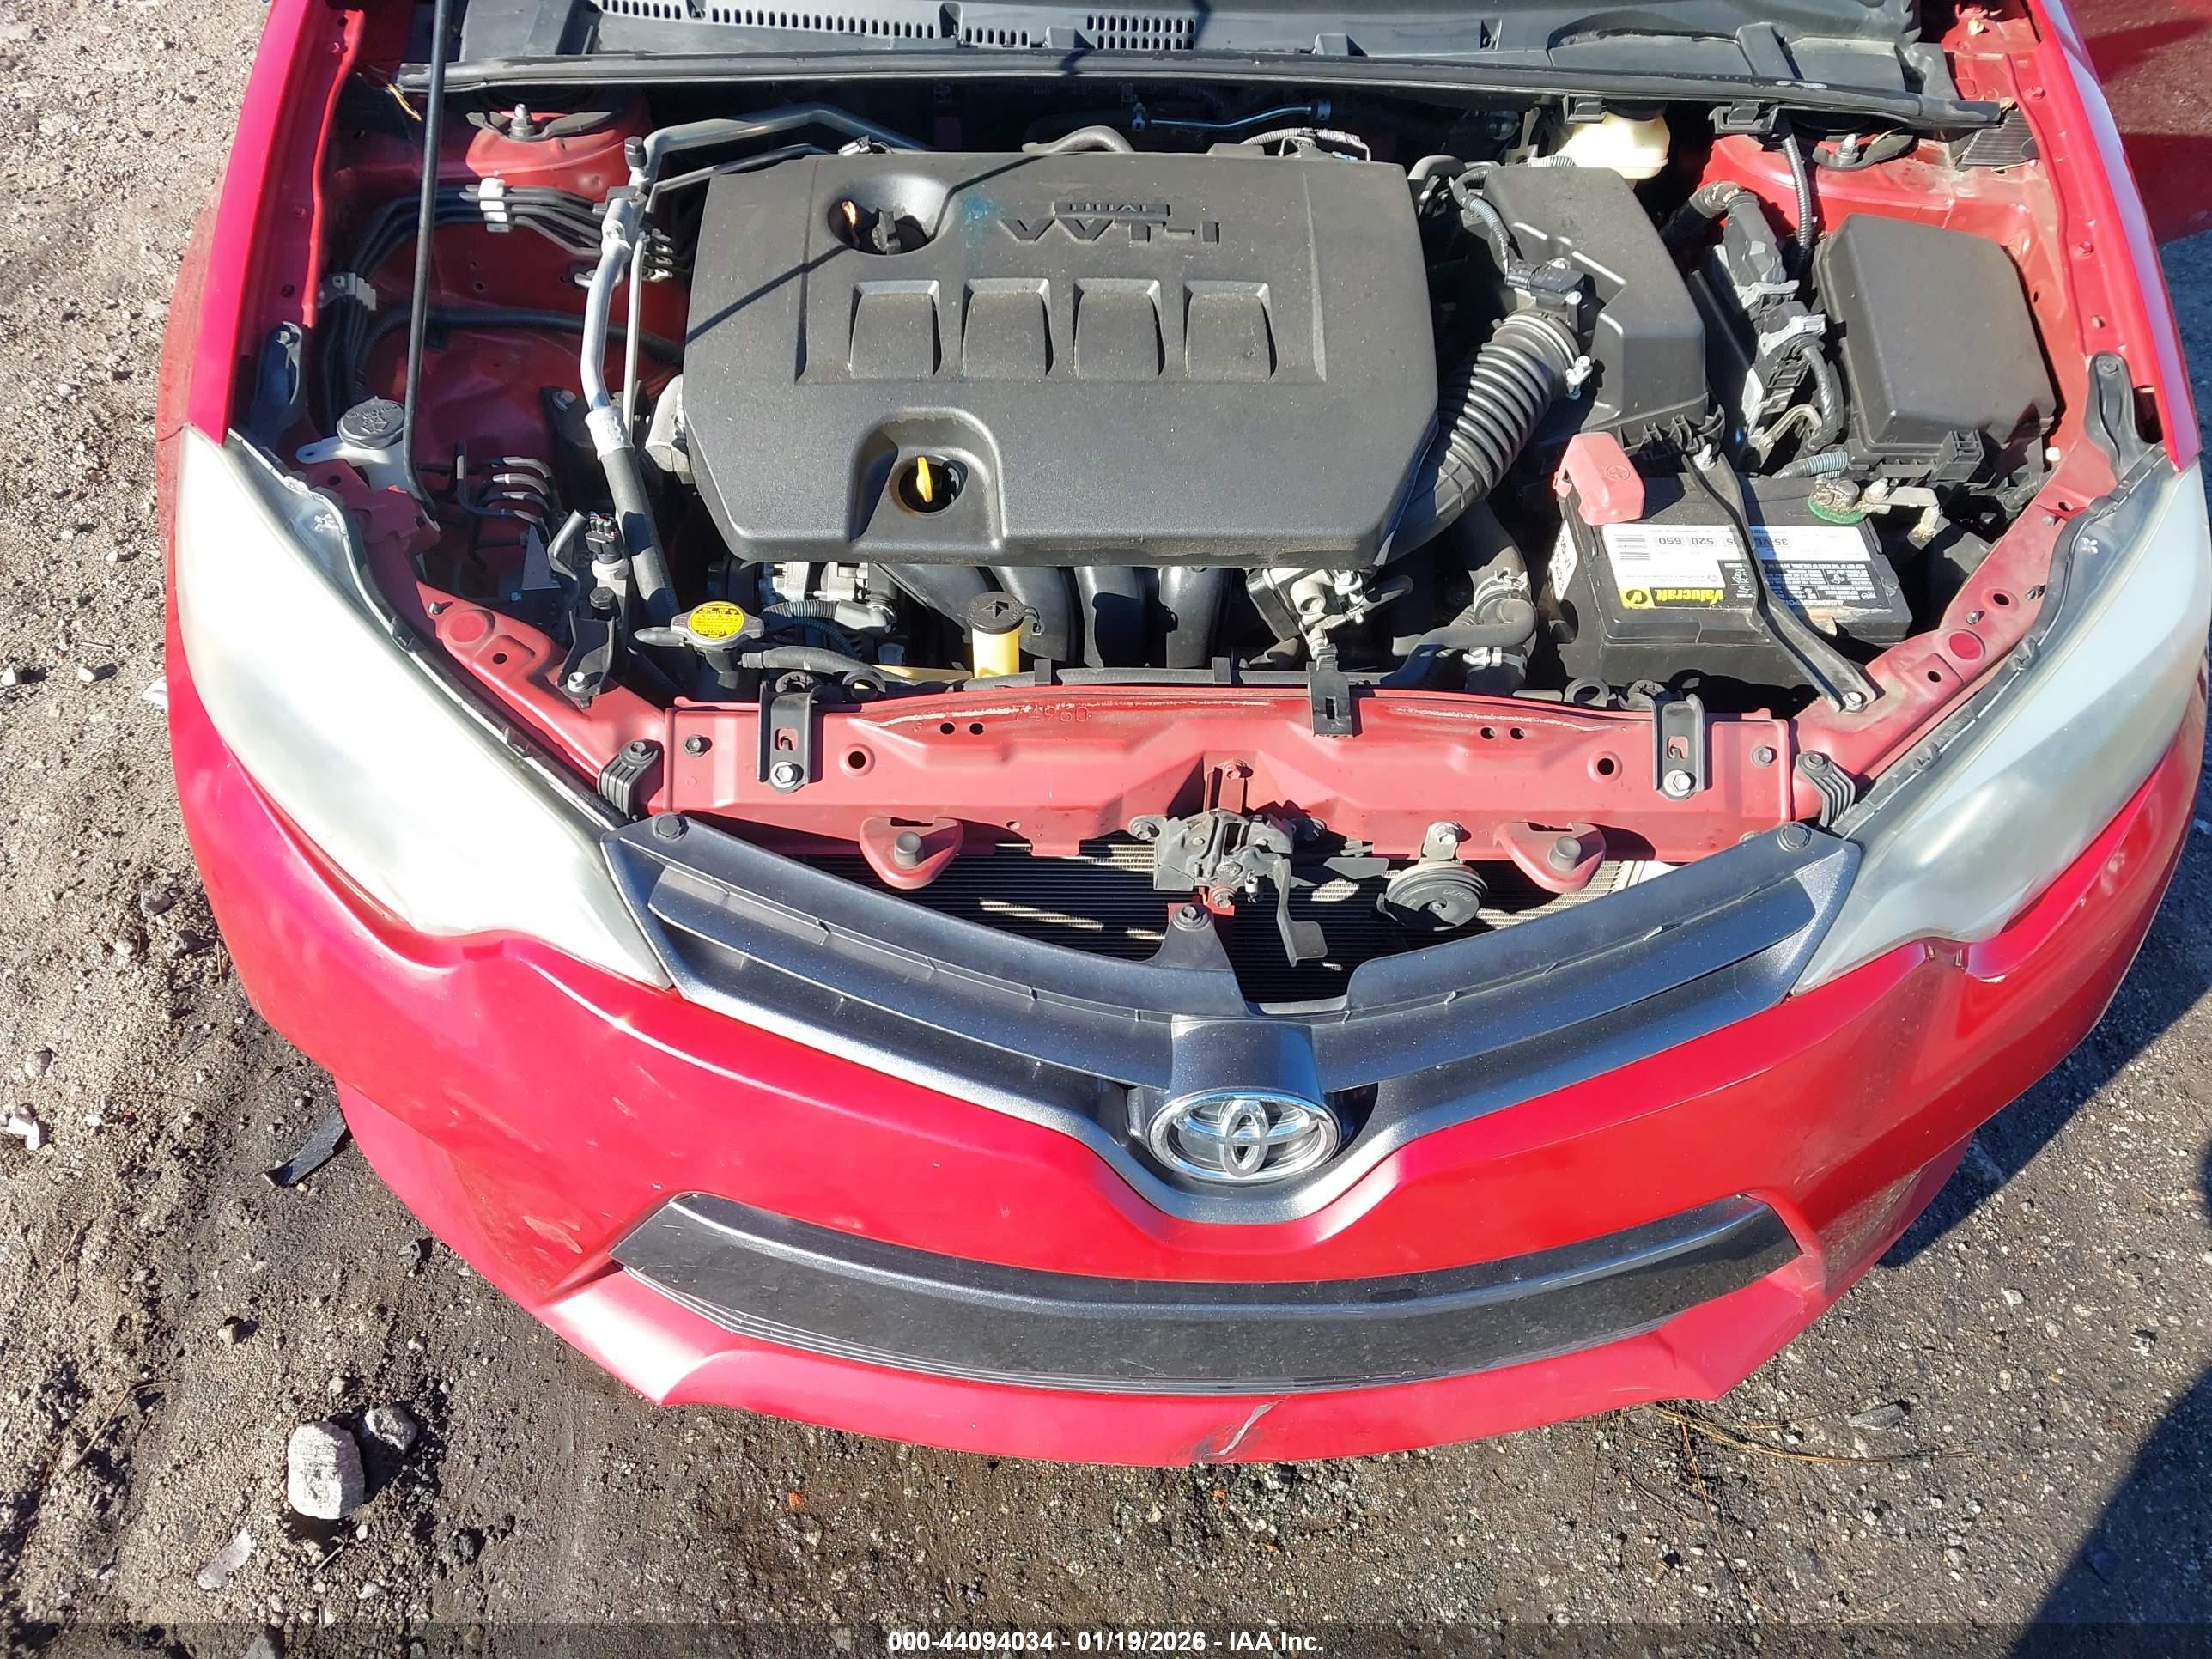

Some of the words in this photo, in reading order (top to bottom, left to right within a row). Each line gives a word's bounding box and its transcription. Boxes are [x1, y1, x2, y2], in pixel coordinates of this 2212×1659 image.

[1658, 537, 1682, 545] 650
[1691, 537, 1715, 545] 520
[1654, 589, 1724, 605] Valucraft
